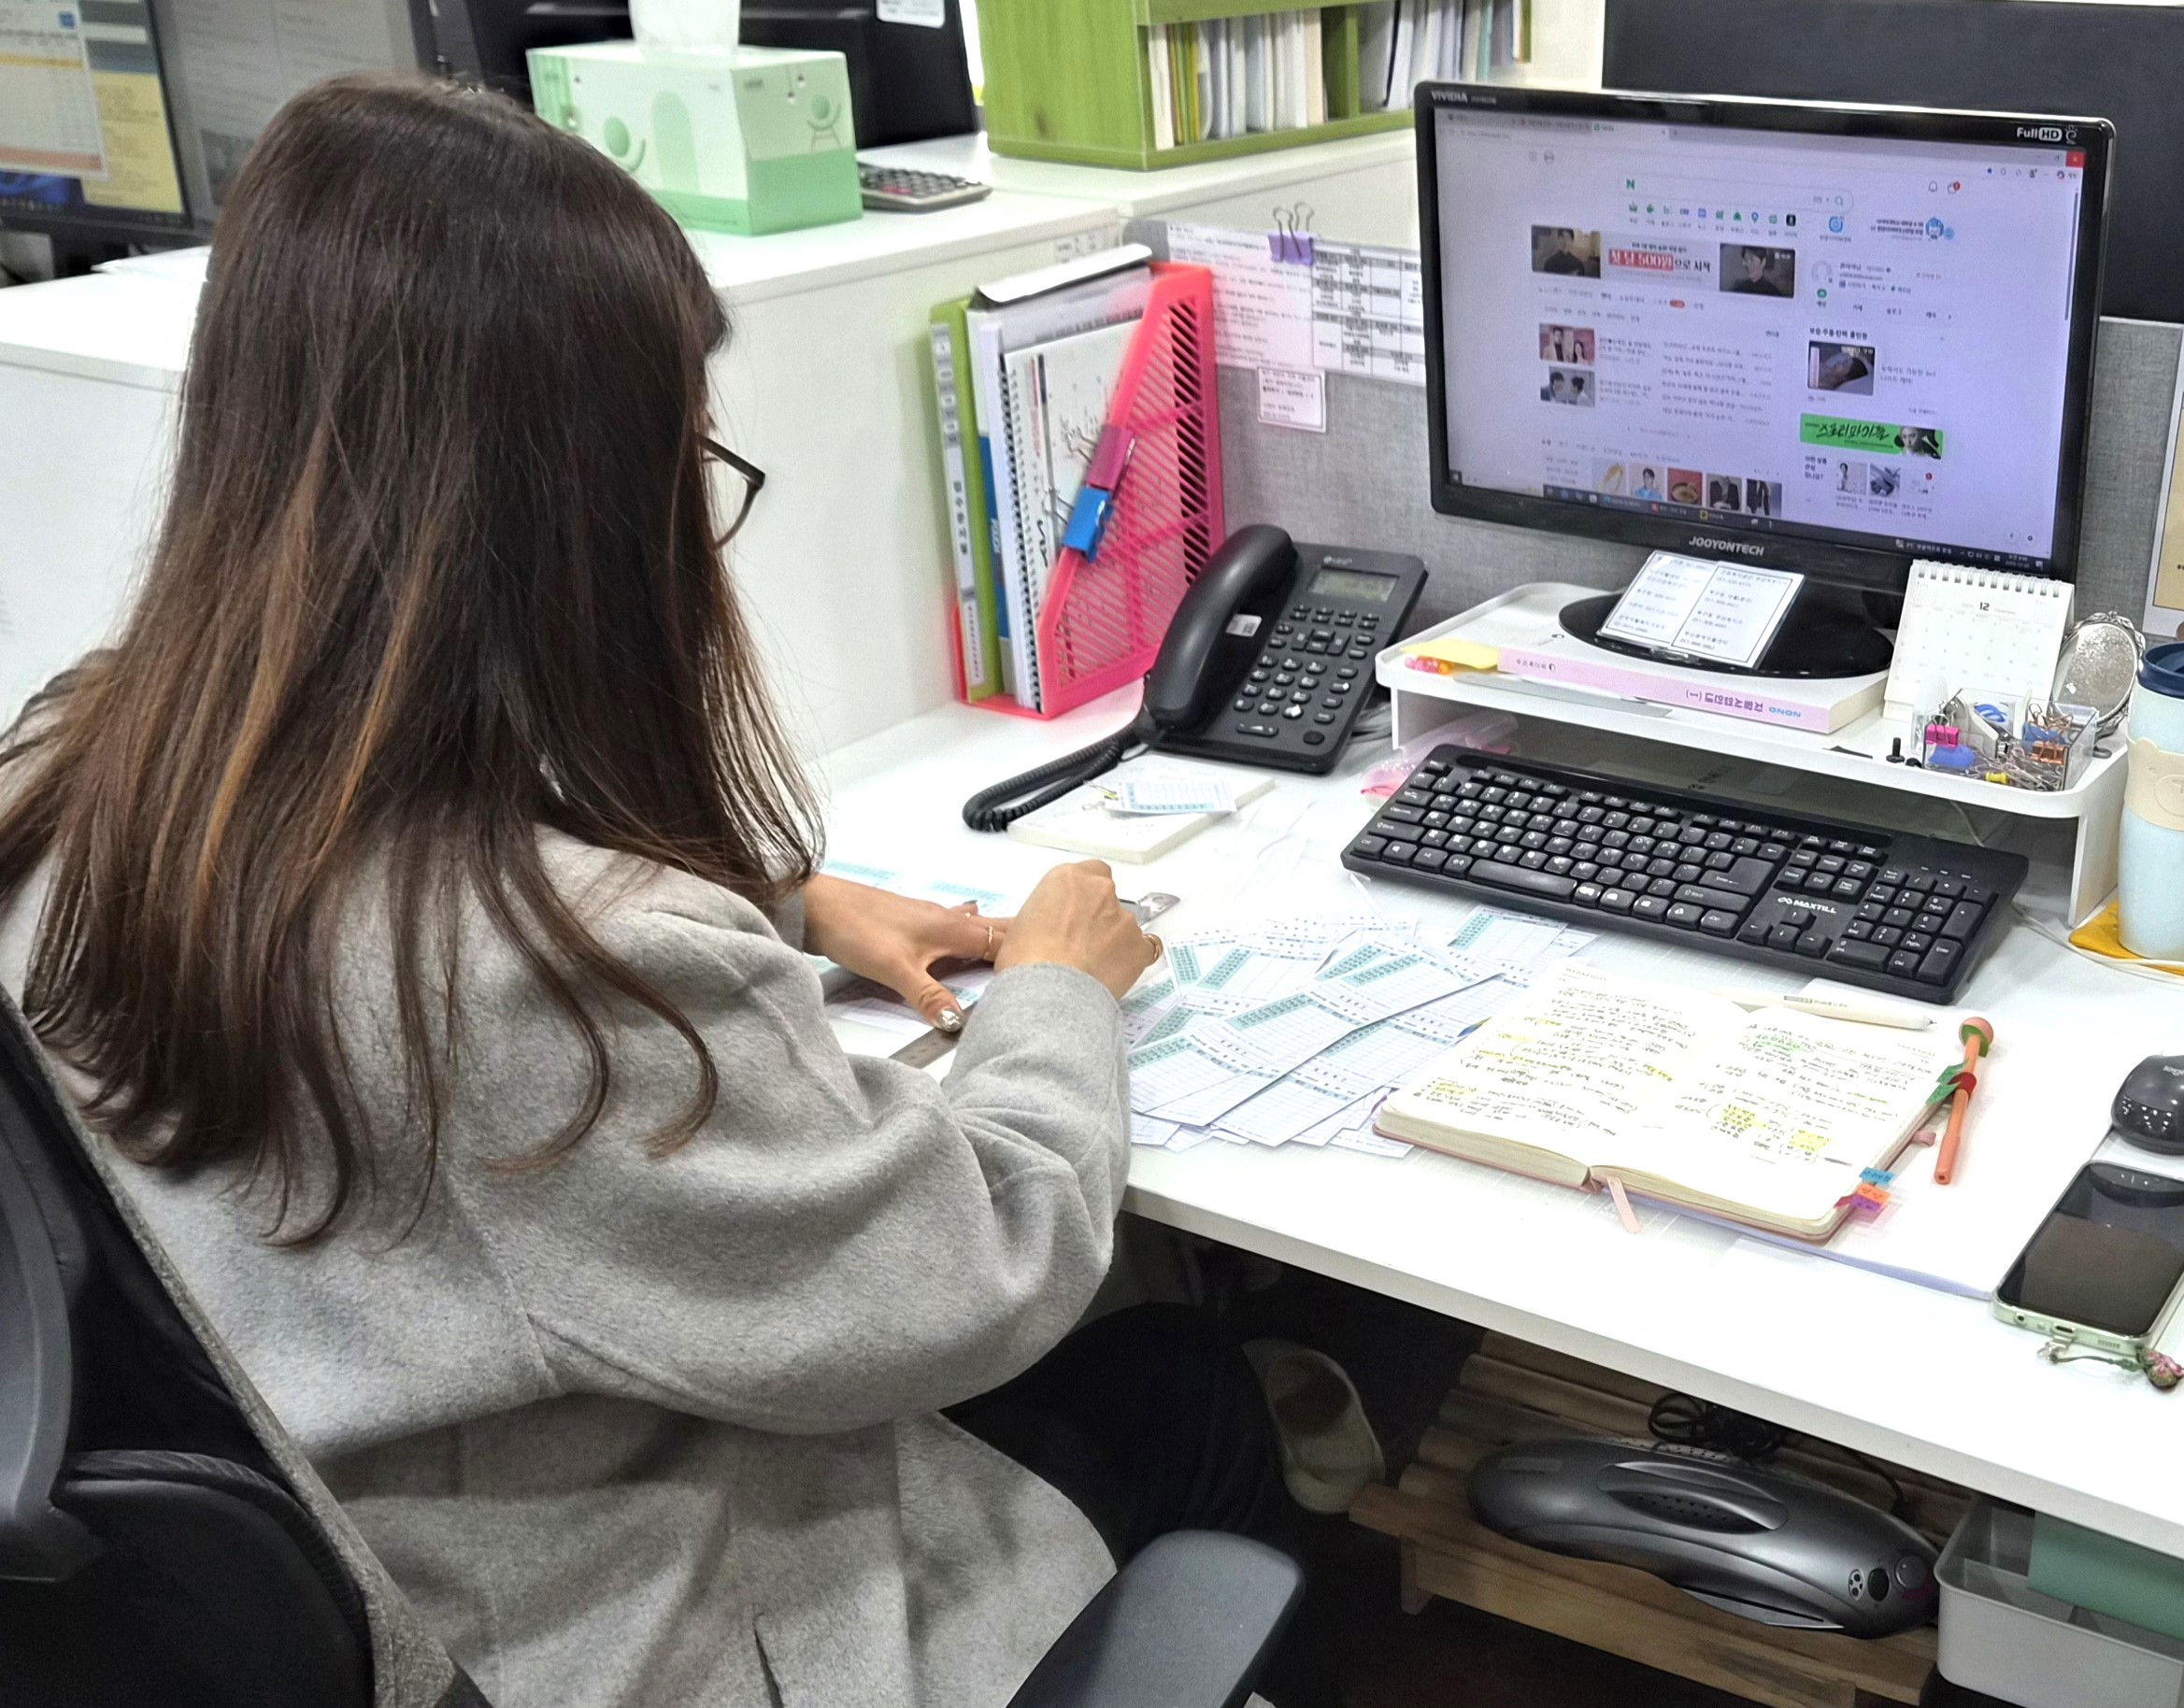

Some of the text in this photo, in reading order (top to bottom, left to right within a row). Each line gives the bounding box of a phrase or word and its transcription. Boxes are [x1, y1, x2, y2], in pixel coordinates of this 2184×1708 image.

[2017, 127, 2063, 142] Full HD
[1689, 536, 1764, 557] JOOYONTECH
[1978, 602, 1990, 611] 12
[1767, 705, 1802, 719] 2020
[1793, 900, 1837, 914] MAXTILL
